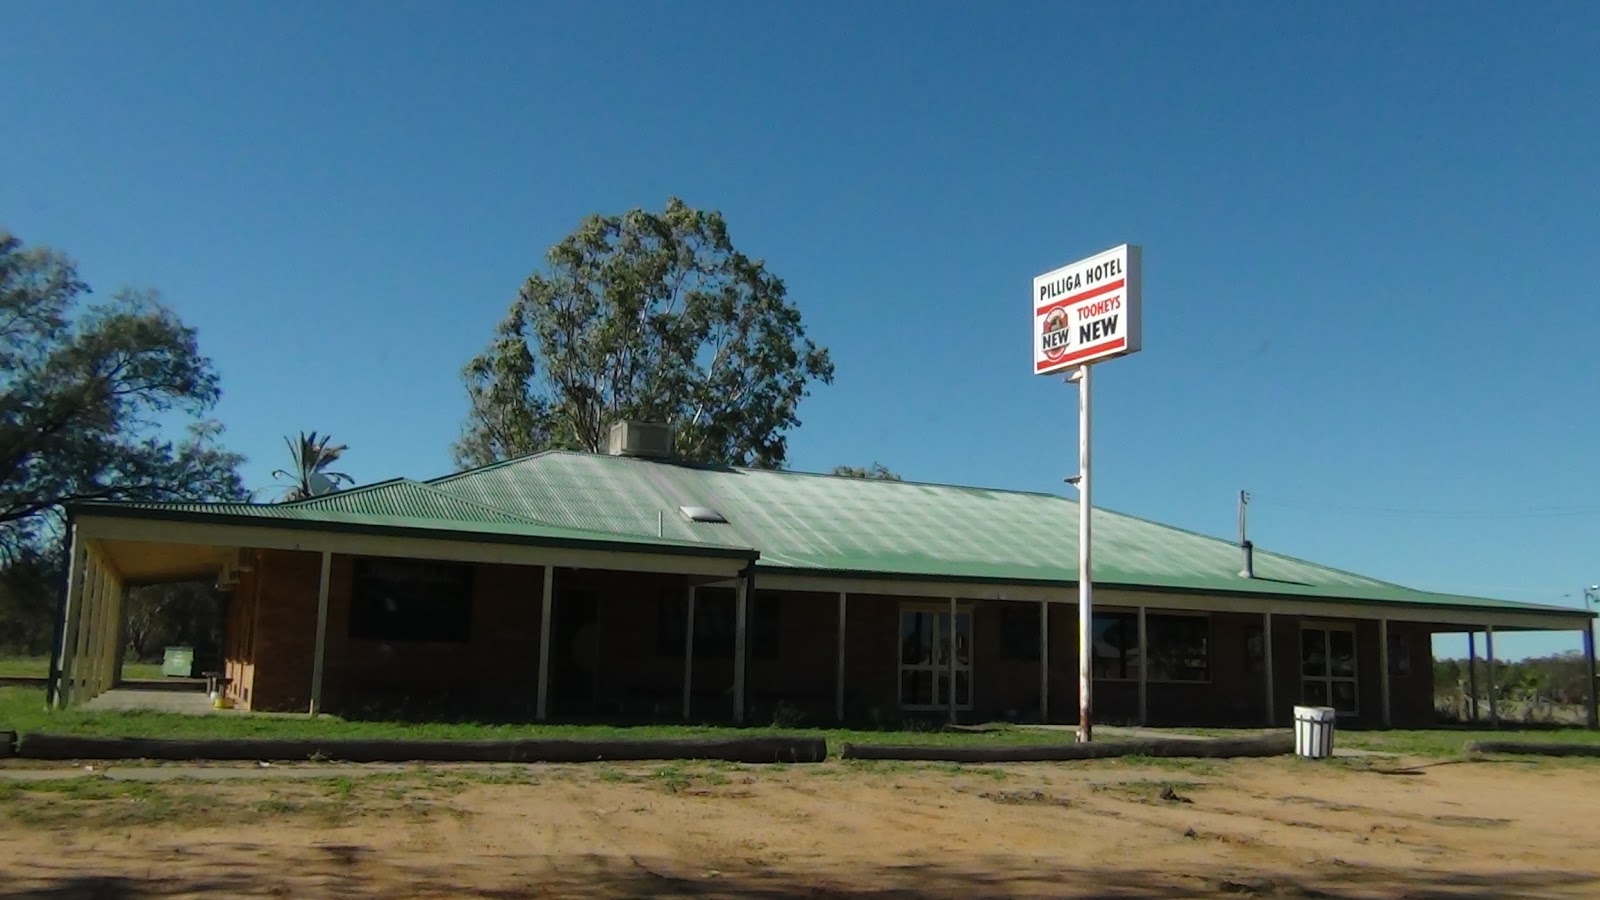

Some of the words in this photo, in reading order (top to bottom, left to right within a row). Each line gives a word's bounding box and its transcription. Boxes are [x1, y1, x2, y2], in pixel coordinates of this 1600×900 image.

[1040, 273, 1082, 301] PILLIGA
[1086, 258, 1122, 285] HOTEL
[1077, 295, 1121, 321] TOOHEYS
[1042, 328, 1070, 350] NEW
[1079, 314, 1119, 345] NEW
